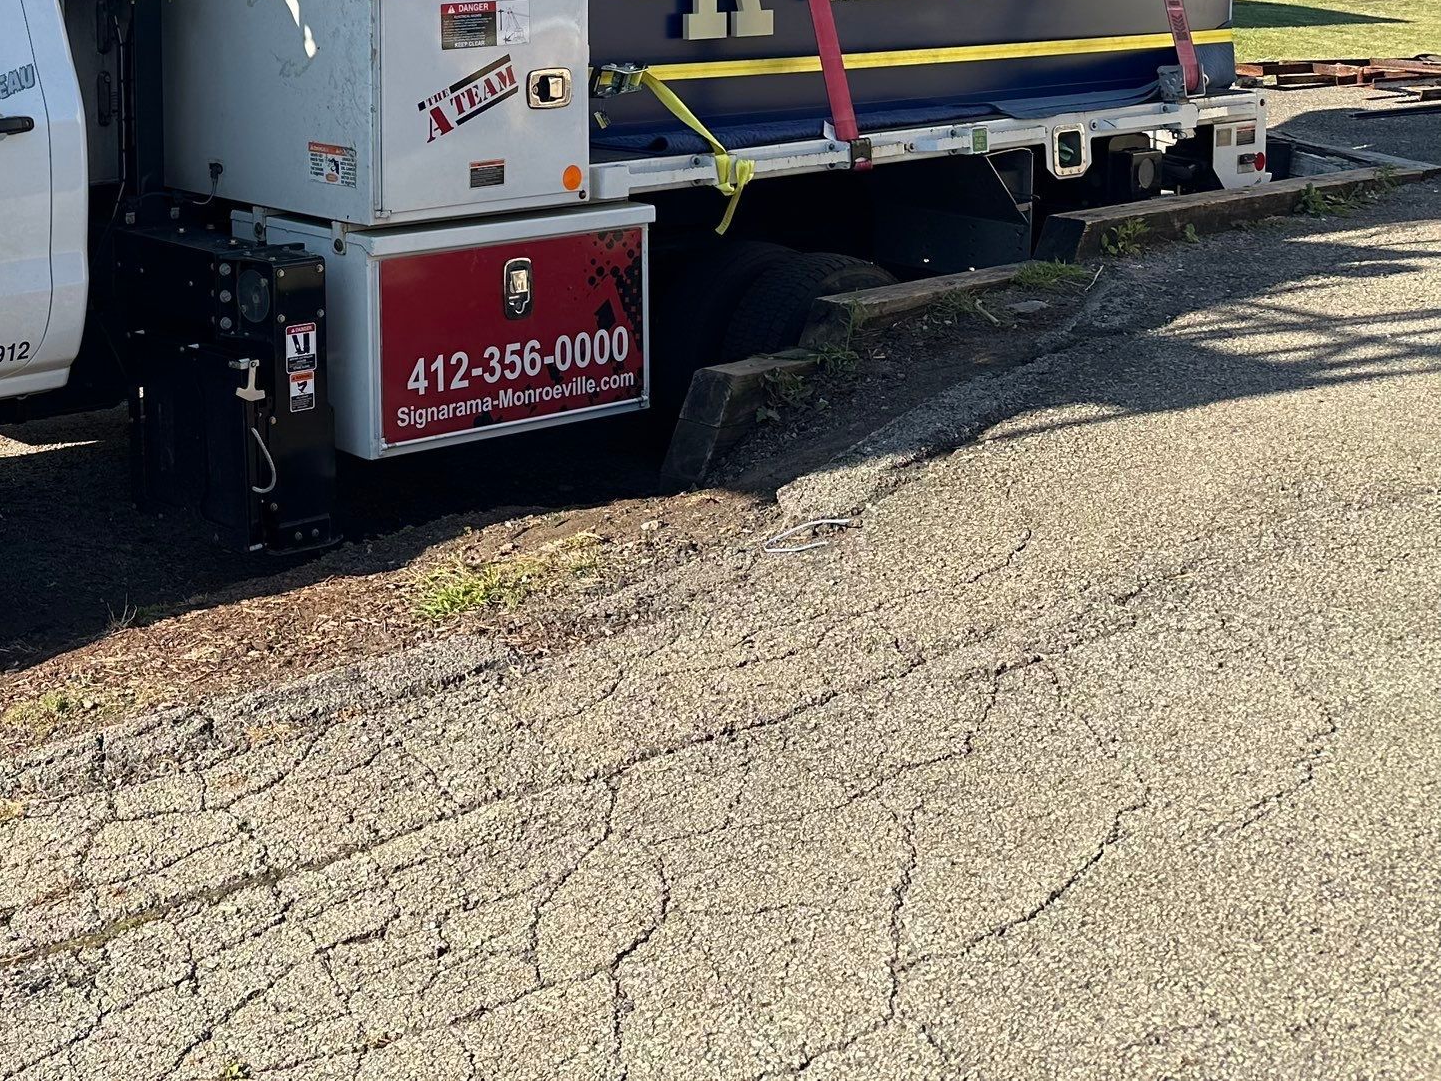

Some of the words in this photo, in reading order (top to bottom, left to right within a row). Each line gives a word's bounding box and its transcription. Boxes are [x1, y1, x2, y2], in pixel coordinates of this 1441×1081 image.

[458, 3, 489, 13] DANGER
[425, 87, 451, 107] THE
[426, 106, 454, 144] A
[450, 64, 517, 116] TEAM
[406, 324, 630, 396] 412-356-0000
[396, 369, 635, 429] Signarama-Monroeville.com
